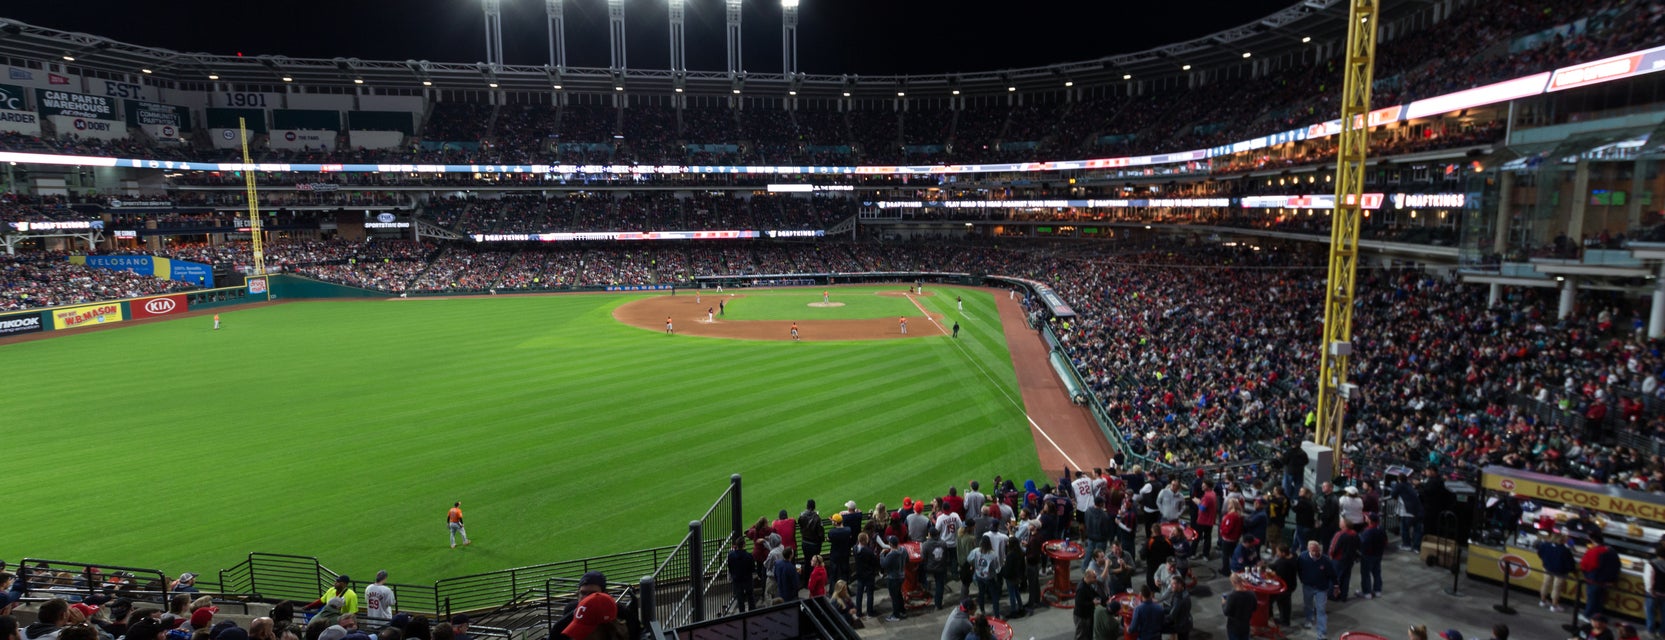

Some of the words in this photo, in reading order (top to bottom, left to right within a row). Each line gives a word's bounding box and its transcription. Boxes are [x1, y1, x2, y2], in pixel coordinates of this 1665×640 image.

[105, 81, 146, 99] EST.
[45, 91, 69, 101] CAR
[71, 94, 106, 106] PARTS
[226, 93, 267, 107] 1901
[43, 98, 110, 114] WAREHOUSE
[139, 111, 177, 120] COMMUNITY
[88, 121, 110, 131] DOBY
[1406, 194, 1464, 207] DRAFTKINGS
[30, 221, 90, 229] DRAFTKINGS
[233, 219, 243, 228] THE
[89, 258, 148, 266] VELOSANO
[151, 301, 170, 311] KIA
[1079, 485, 1090, 495] 22
[1536, 485, 1600, 507] LOCOS
[947, 524, 956, 534] 19
[368, 599, 379, 610] 59
[575, 605, 587, 619] C
